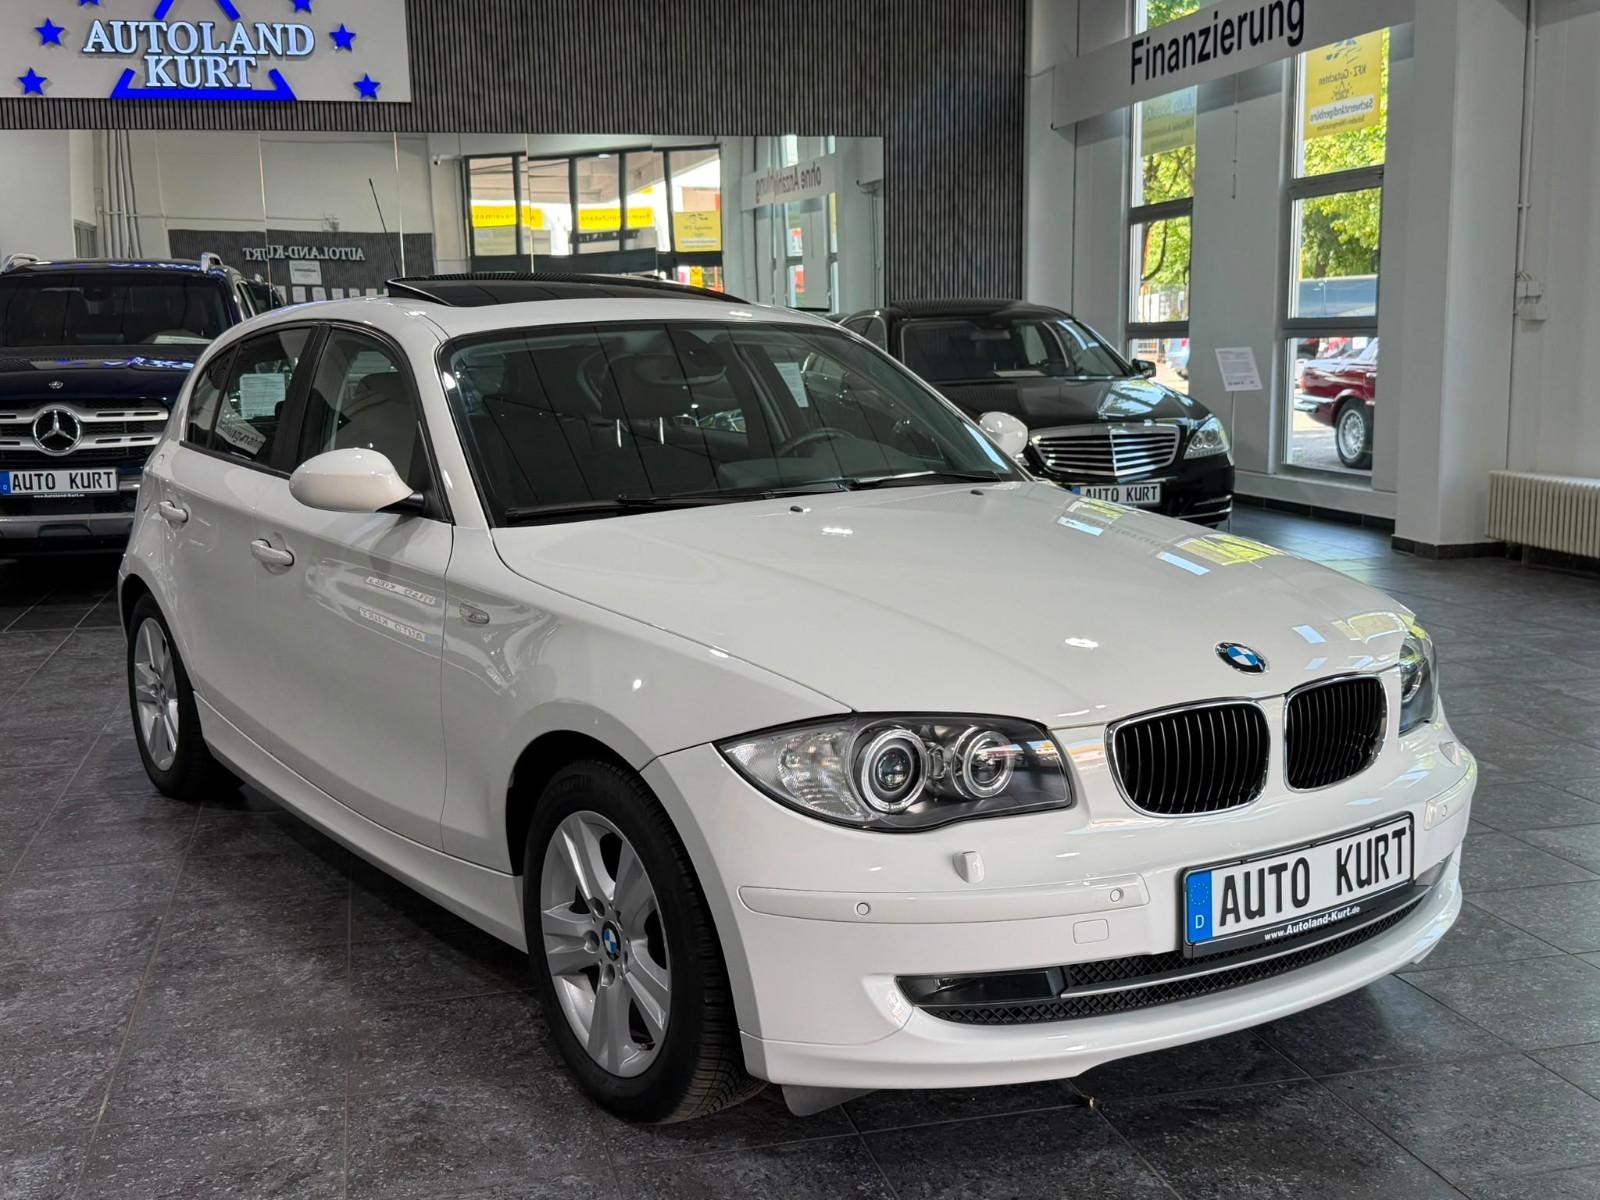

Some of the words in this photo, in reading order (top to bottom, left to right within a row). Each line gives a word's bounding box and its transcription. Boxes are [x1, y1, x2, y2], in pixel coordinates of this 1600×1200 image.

[83, 20, 315, 57] AUTOLAND
[1130, 0, 1305, 85] Finanzierung
[144, 55, 257, 89] KURT
[12, 473, 56, 491] AUTO
[69, 472, 113, 489] KURT
[1085, 487, 1120, 503] AUTO
[1126, 486, 1158, 502] KURT
[1195, 914, 1205, 929] D
[1219, 857, 1311, 927] AUTO
[1336, 826, 1407, 896] KURT
[1264, 905, 1361, 941] www.Autoland-Kurt.de
